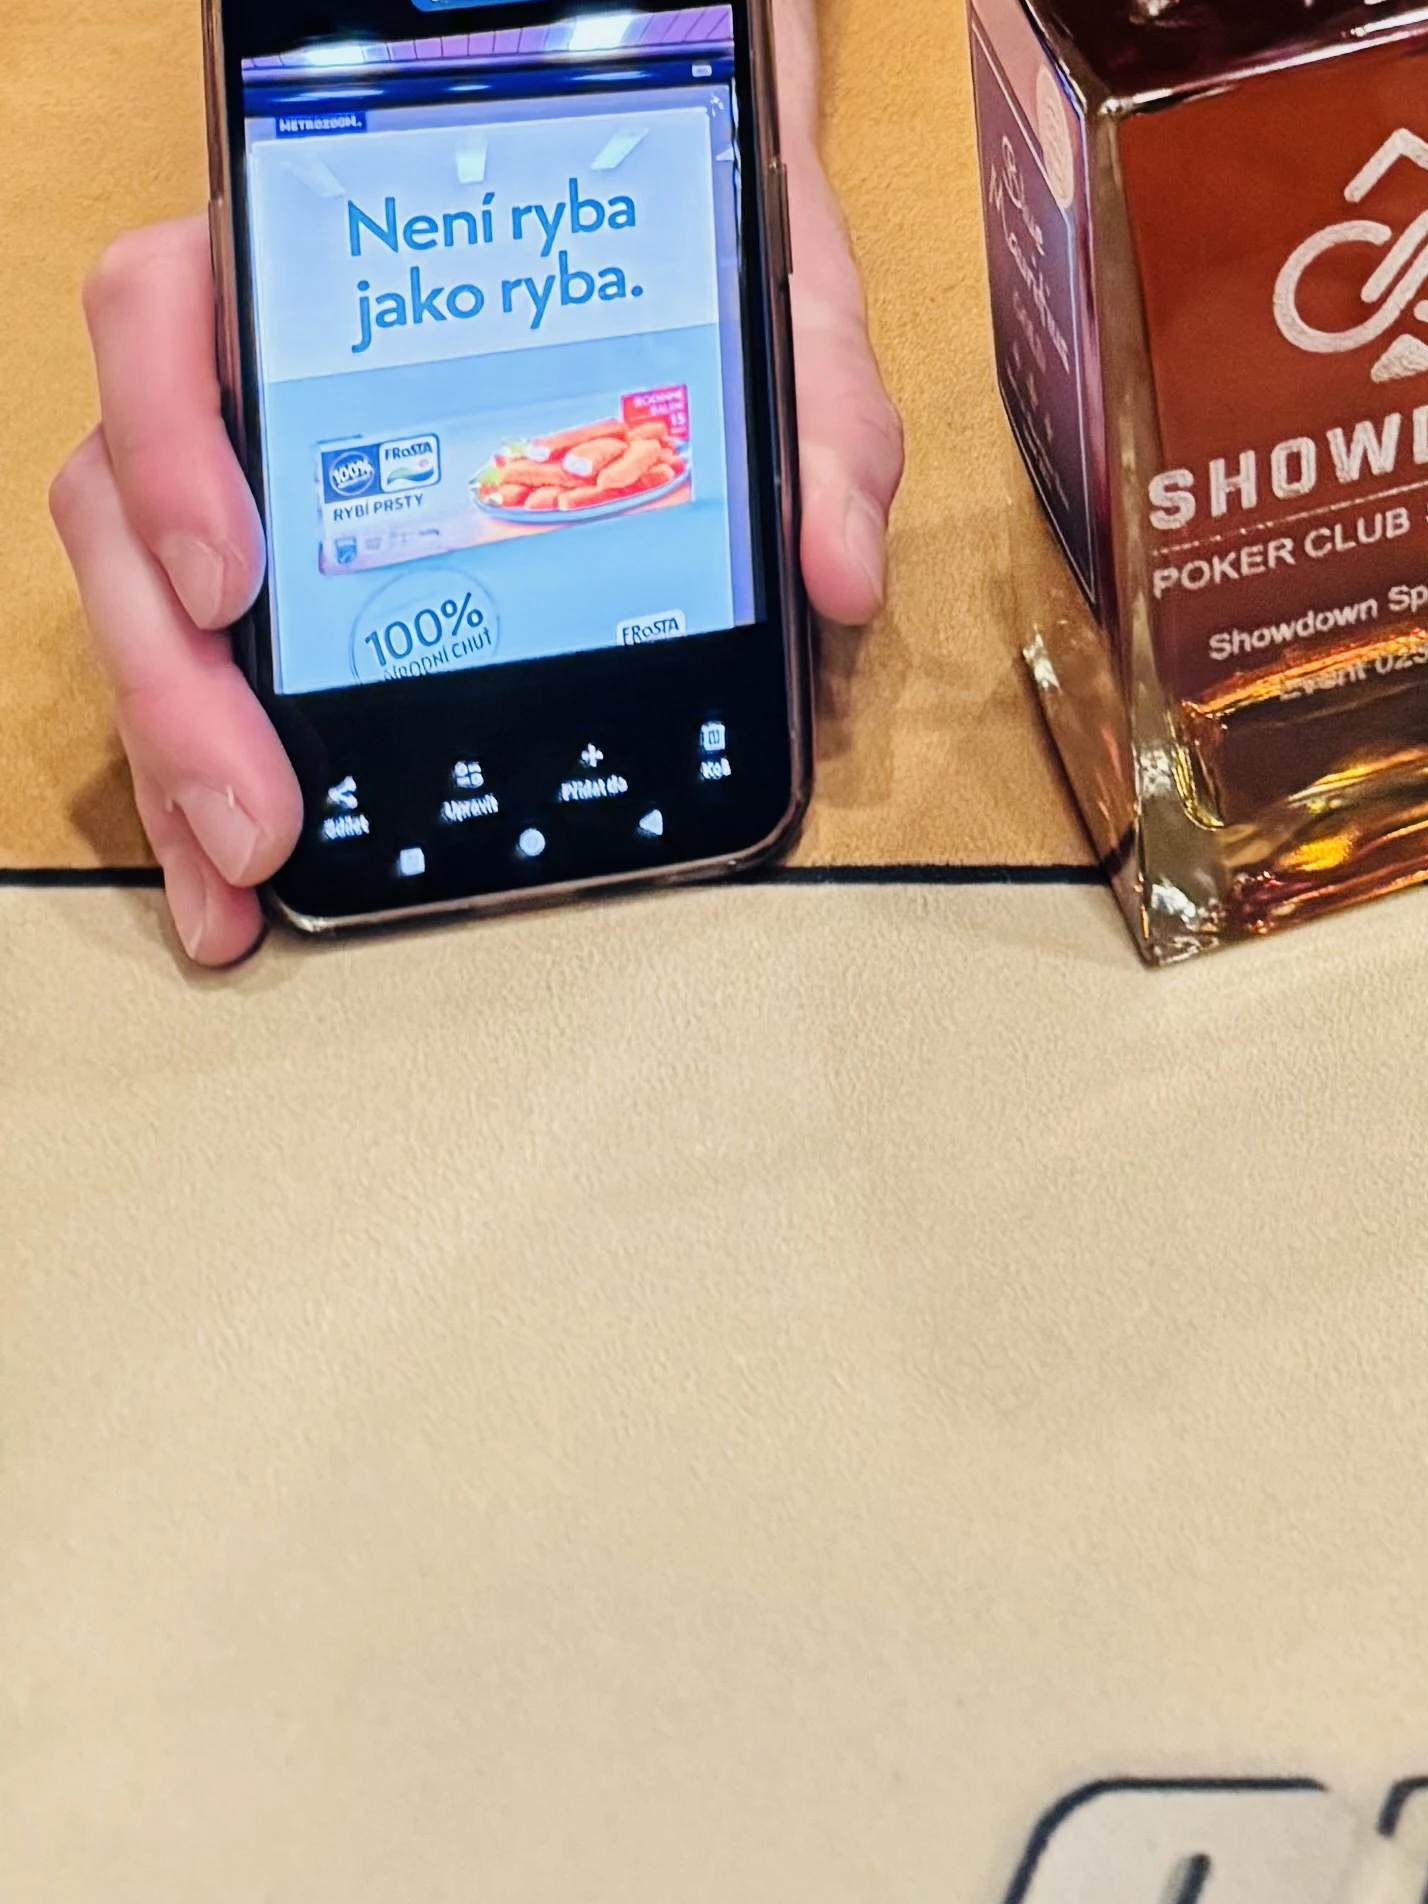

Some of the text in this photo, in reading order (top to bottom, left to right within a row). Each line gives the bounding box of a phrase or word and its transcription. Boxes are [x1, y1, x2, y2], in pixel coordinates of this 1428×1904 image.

[347, 178, 636, 258] Není ryba
[351, 250, 644, 354] jako ryba.
[332, 458, 374, 485] 100%
[333, 493, 424, 521] RYBÍ PRSTY
[1153, 538, 1296, 599] POKER
[1304, 507, 1410, 558] CLUB
[365, 592, 484, 666] 100%
[1208, 599, 1378, 660] Showdown
